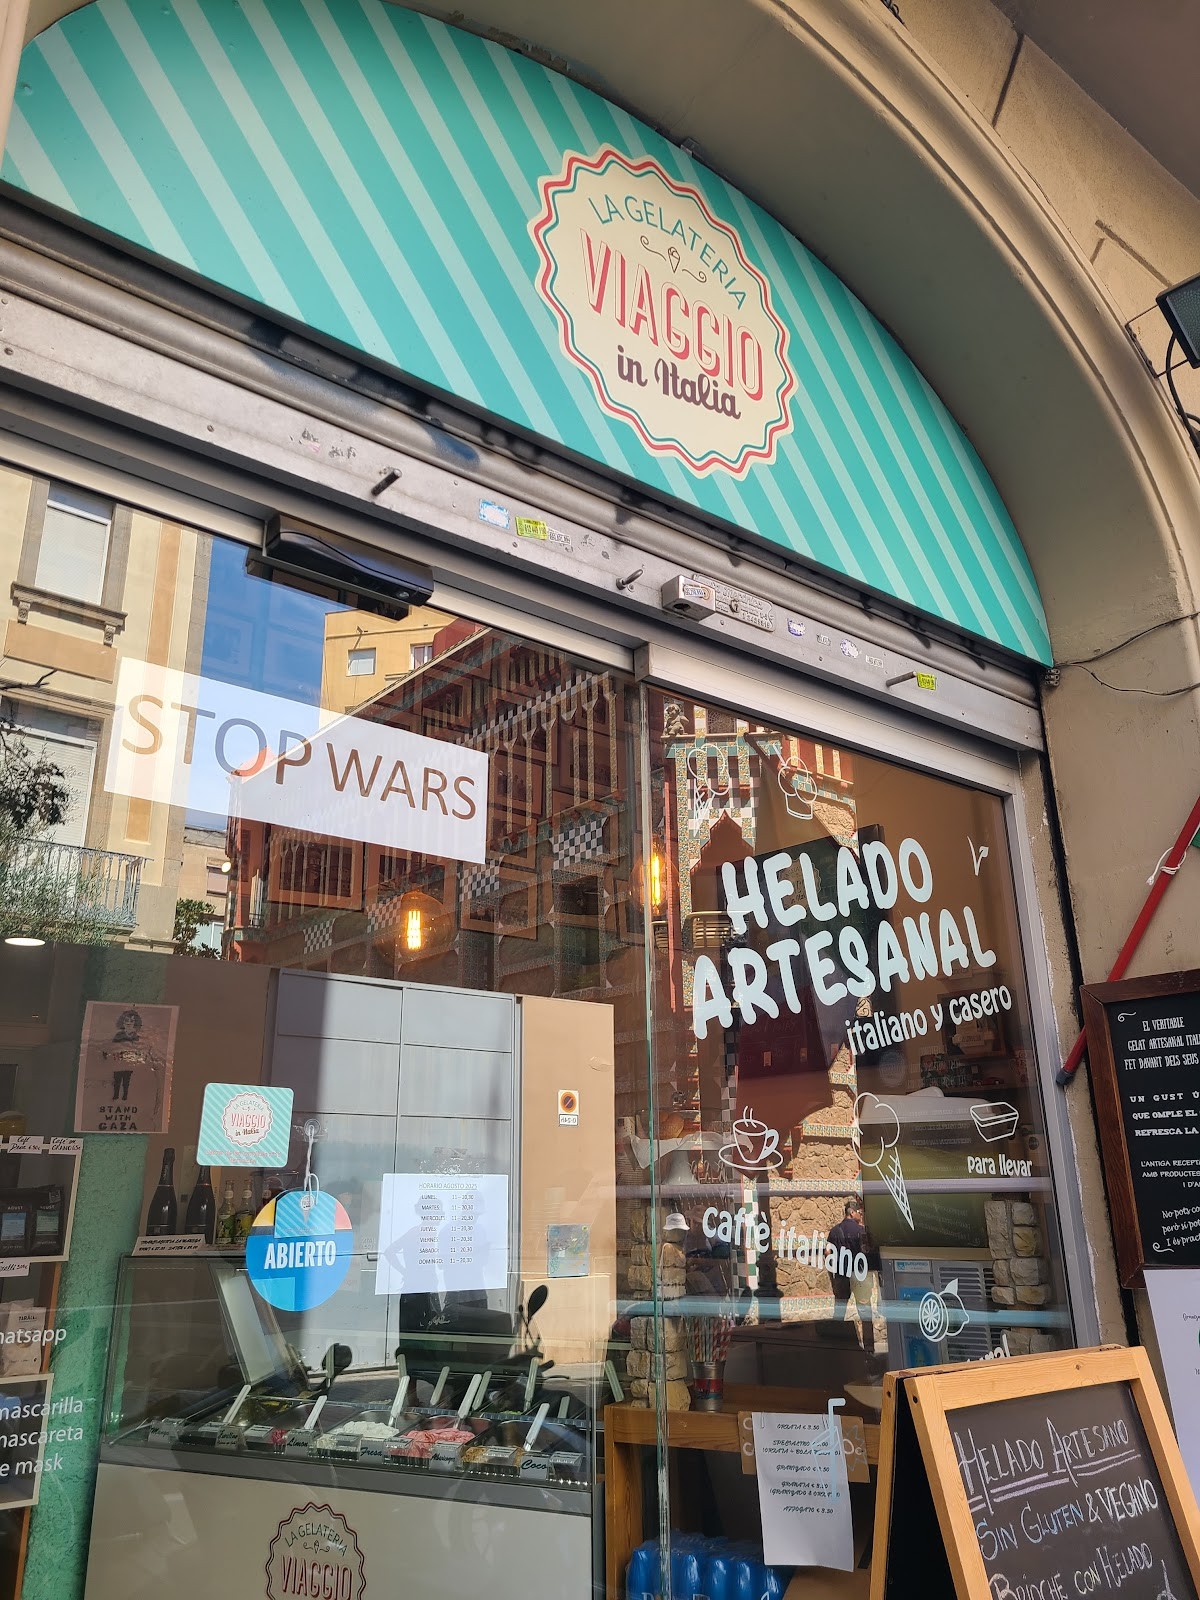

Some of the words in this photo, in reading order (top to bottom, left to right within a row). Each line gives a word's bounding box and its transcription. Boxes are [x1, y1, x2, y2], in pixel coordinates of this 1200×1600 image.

[588, 193, 624, 224] LA
[624, 195, 747, 310] GELATERIA
[579, 227, 764, 402] VIAGGIO
[616, 344, 648, 388] in
[654, 357, 741, 420] Italia
[122, 694, 313, 785] STOP
[326, 741, 477, 821] WARS
[722, 837, 933, 936] HELADO
[692, 905, 996, 1040] ARTESANAL
[845, 1007, 928, 1056] italiano
[930, 1003, 944, 1032] y
[949, 985, 1012, 1025] casero
[1142, 1020, 1150, 1032] EL
[1152, 1016, 1185, 1030] VERITABLE
[1127, 1039, 1146, 1052] GELAT
[1149, 1035, 1184, 1050] ARTESANAL
[1124, 1058, 1137, 1070] FET
[1138, 1056, 1163, 1069] DAVANT
[1164, 1054, 1181, 1067] DELS
[1182, 1053, 1200, 1066] SEUS
[1129, 1095, 1145, 1103] UN
[1152, 1092, 1184, 1102] GUST
[99, 1106, 138, 1114] STAND
[1132, 1112, 1151, 1120] QUE
[1152, 1110, 1184, 1118] OMPLE
[98, 1122, 138, 1130] GAZA
[231, 1113, 266, 1128] VIAGGIO
[1134, 1128, 1184, 1136] REFRESCA
[1184, 1126, 1200, 1134] LA
[967, 1154, 996, 1176] para
[998, 1154, 1034, 1178] llevar
[1140, 1160, 1172, 1168] L'ANTIGA
[1160, 1170, 1200, 1178] PRODUCTES
[1162, 1210, 1174, 1219] No
[1174, 1206, 1190, 1220] pots
[1162, 1222, 1180, 1236] però
[702, 1206, 770, 1254] caffè
[777, 1220, 869, 1282] italiano
[1166, 1238, 1171, 1246] I
[264, 1240, 337, 1270] ABIERTO
[360, 1446, 382, 1457] Fresa
[15, 1453, 64, 1476] mask
[521, 1459, 548, 1470] Coco
[954, 1428, 1044, 1515] HELADO
[1046, 1417, 1129, 1488] ARTESANO
[976, 1518, 1018, 1561] SIN
[1020, 1501, 1084, 1544] GLUTEN
[1085, 1493, 1102, 1524] &
[1095, 1476, 1159, 1522] VEGANO
[284, 1531, 298, 1548] LA
[298, 1522, 348, 1558] GELATERIA
[281, 1555, 352, 1600] VIAGGIO
[1074, 1561, 1102, 1595] CON
[1096, 1542, 1153, 1588] HELADO
